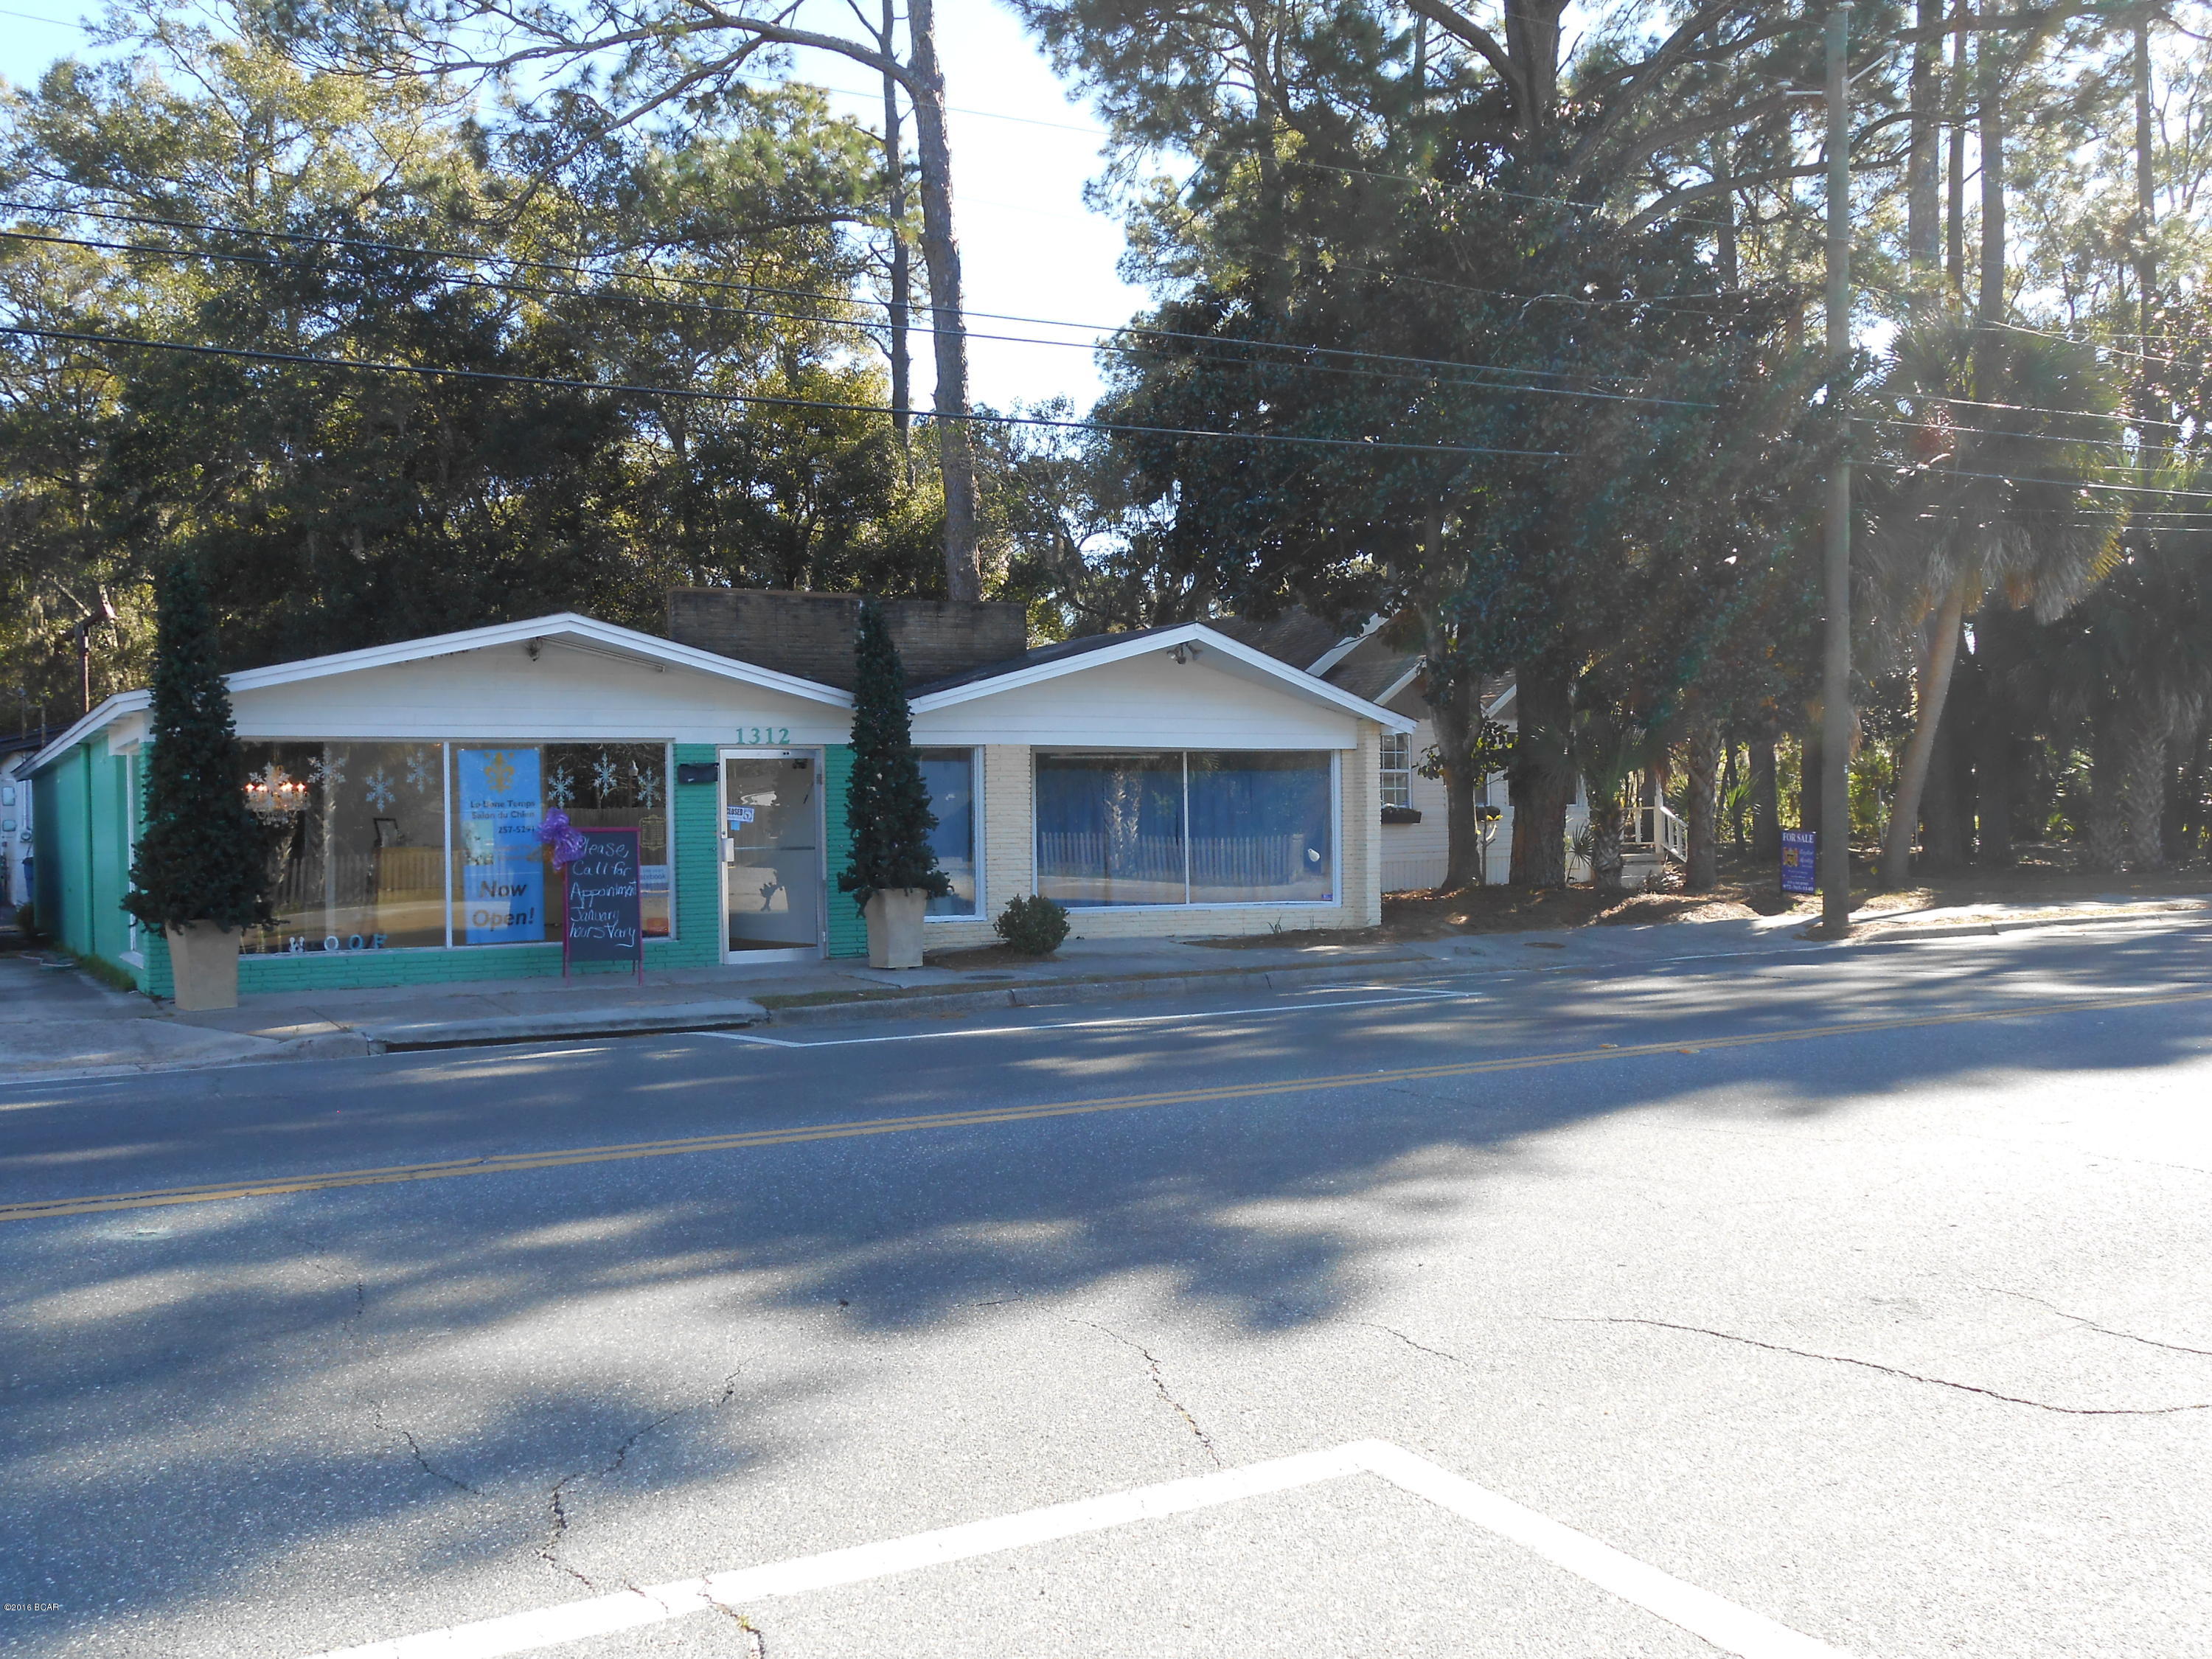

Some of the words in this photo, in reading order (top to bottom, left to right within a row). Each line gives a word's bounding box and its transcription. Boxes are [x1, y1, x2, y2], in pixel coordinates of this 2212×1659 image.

[736, 727, 790, 745] 1312
[472, 811, 495, 819] Salon
[498, 810, 508, 818] du
[727, 807, 743, 816] CLOSED
[1783, 832, 1795, 842] FOR
[1797, 833, 1814, 844] SALE
[573, 860, 607, 876] Call
[611, 861, 633, 877] for
[479, 880, 527, 898] Now
[472, 907, 535, 932] Open!
[570, 907, 619, 925] January
[569, 922, 605, 939] hours
